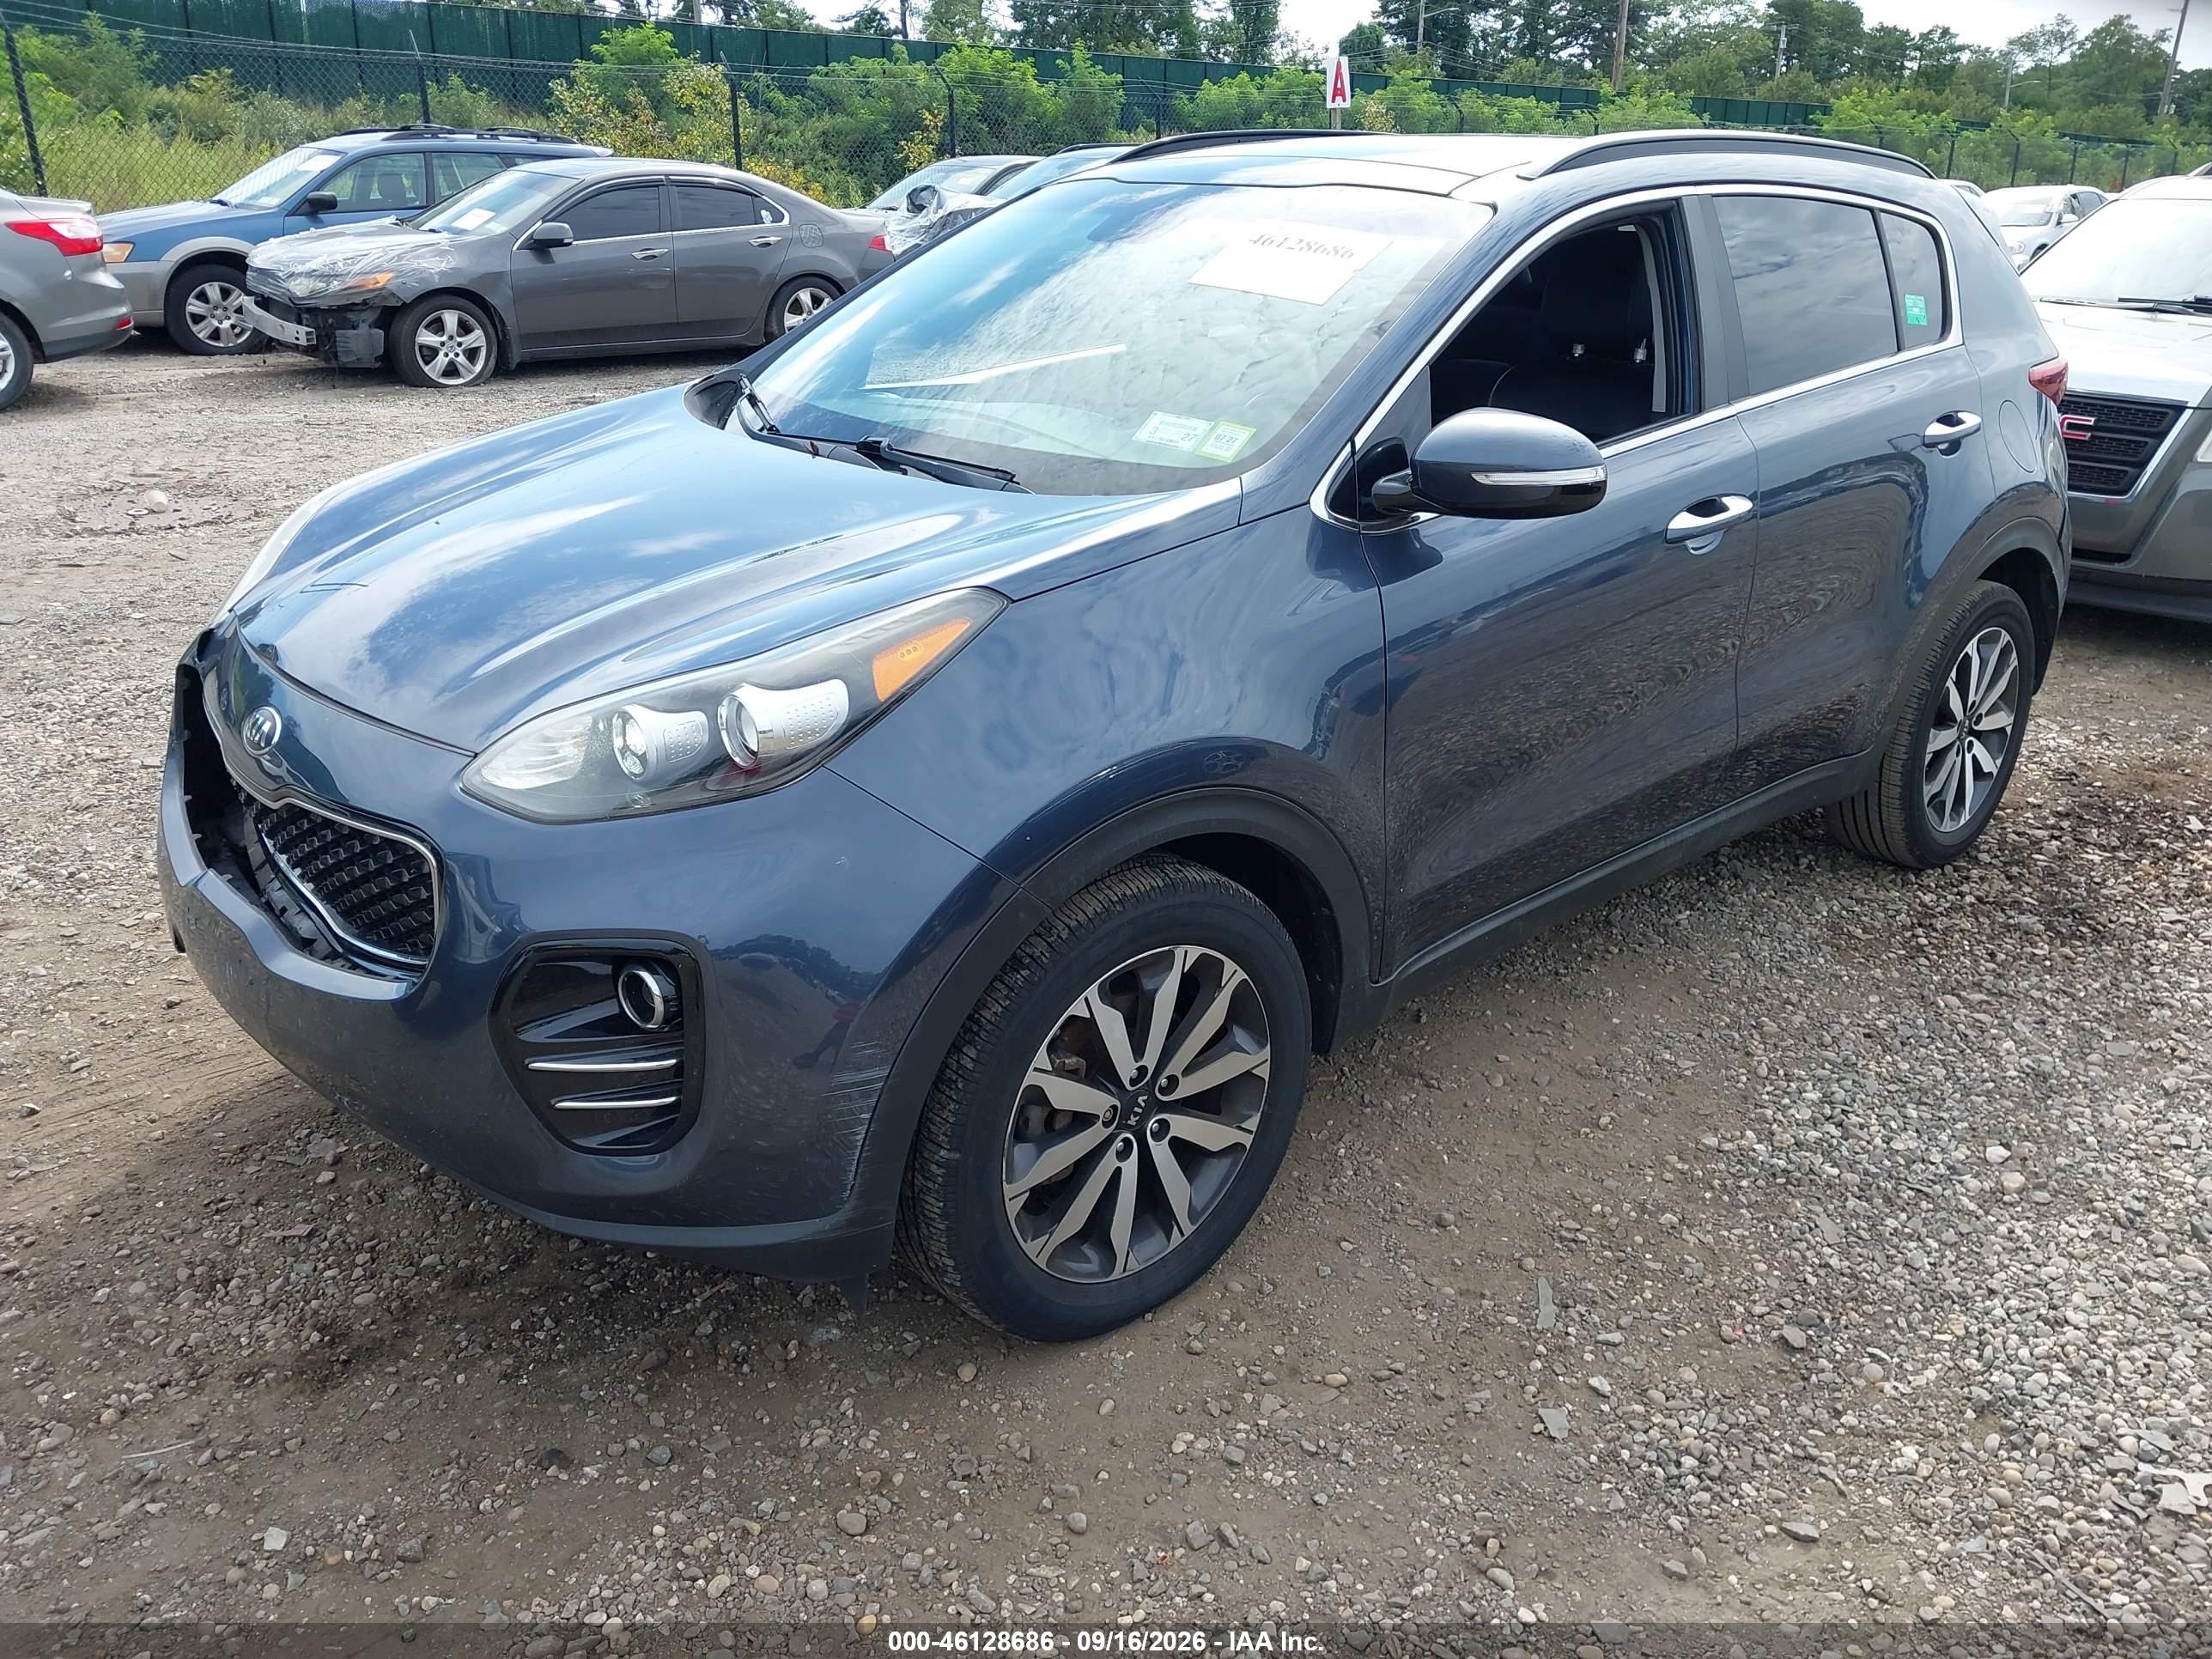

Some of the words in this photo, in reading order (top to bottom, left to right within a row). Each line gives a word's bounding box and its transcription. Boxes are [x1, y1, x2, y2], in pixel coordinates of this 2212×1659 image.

[1331, 59, 1346, 104] A
[1249, 233, 1355, 259] 46128686
[1181, 433, 1197, 441] 27
[1126, 1094, 1149, 1127] KIA
